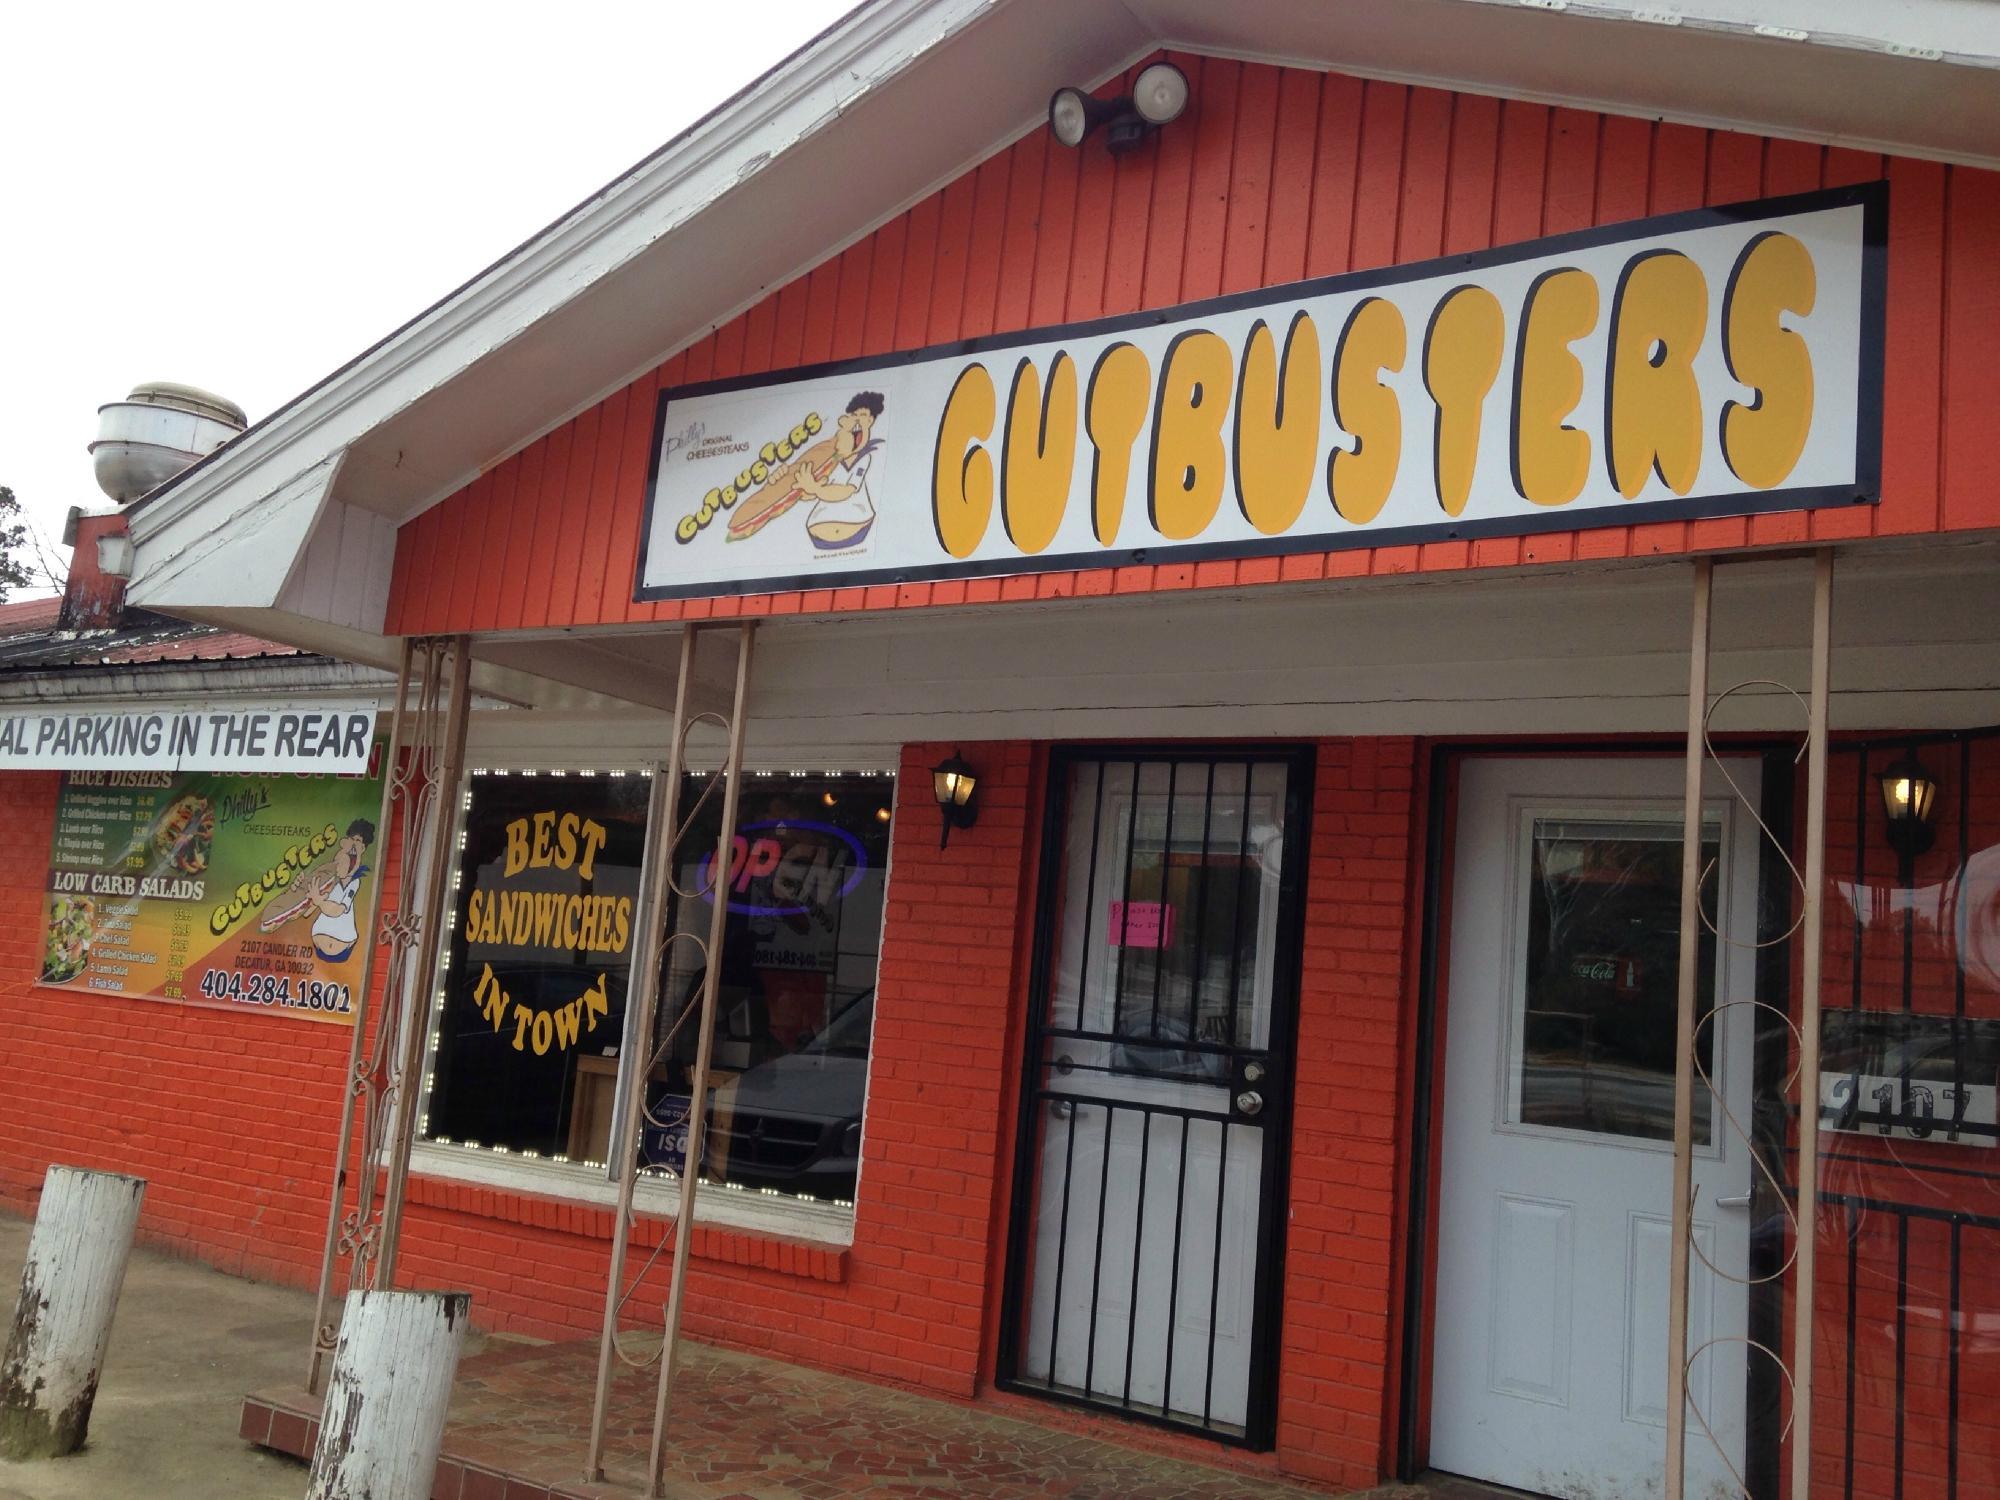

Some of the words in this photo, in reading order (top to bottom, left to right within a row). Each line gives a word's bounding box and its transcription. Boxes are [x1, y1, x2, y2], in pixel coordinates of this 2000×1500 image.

[932, 230, 1817, 560] GUTBUSTERS
[675, 411, 823, 544] GUTBUSTERS
[35, 716, 163, 756] PARKING
[167, 714, 201, 756] IN
[208, 714, 270, 757] THE
[274, 714, 369, 758] REAR
[68, 770, 106, 785] RICE
[109, 771, 173, 788] DISHES
[243, 824, 311, 836] CHEESESTEAKS
[504, 810, 606, 881] BEST
[54, 872, 88, 891] LOW
[91, 875, 135, 895] CARB
[139, 877, 205, 900] SALADS
[210, 823, 339, 935] GUTBUSTERS
[707, 834, 848, 905] OPEN
[465, 888, 632, 953] SANDWICHES
[240, 940, 261, 953] 2107
[263, 943, 297, 957] CANDLER
[299, 946, 313, 959] RD
[275, 958, 286, 972] GA
[201, 968, 351, 1013] 404.284.1801
[473, 962, 510, 1033] IN
[511, 972, 608, 1056] TOWN
